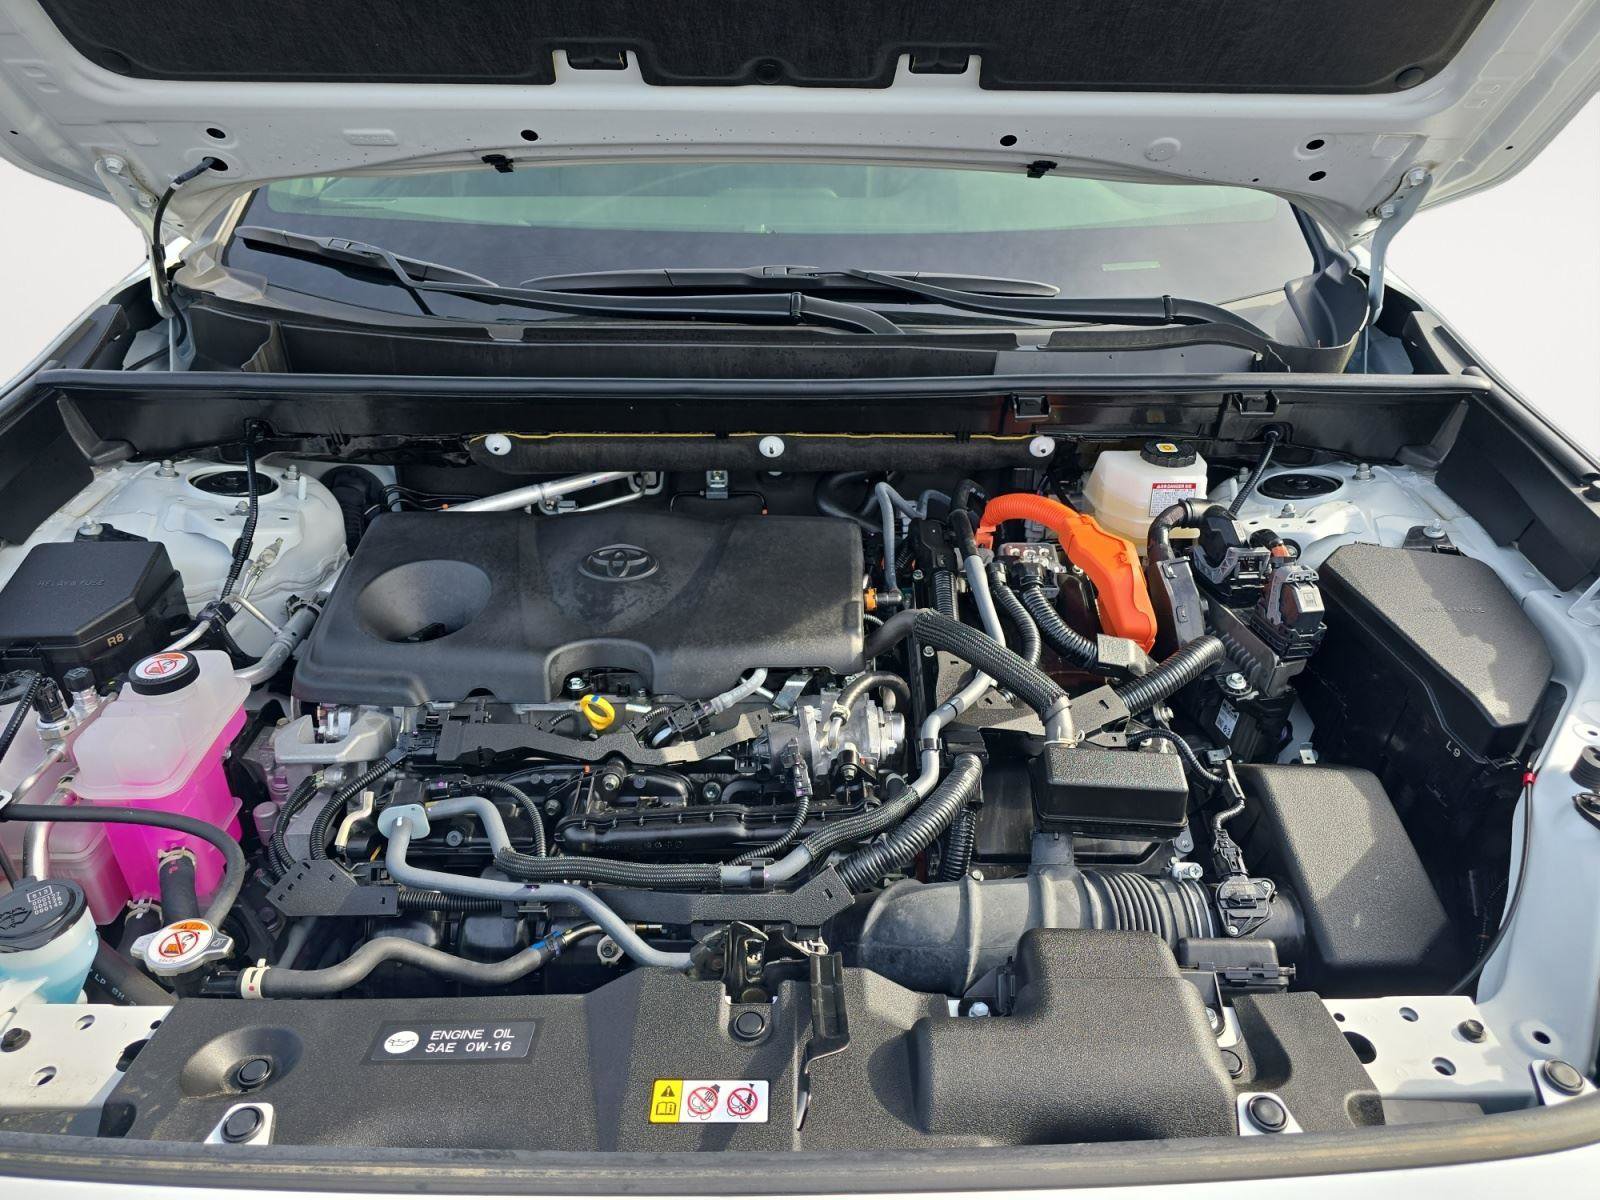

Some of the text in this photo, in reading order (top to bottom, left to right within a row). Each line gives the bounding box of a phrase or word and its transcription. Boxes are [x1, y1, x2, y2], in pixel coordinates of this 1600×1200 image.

[107, 632, 125, 648] R8
[430, 1028, 516, 1041] ENGINE OIL
[425, 1041, 512, 1053] SAE 0W-16
